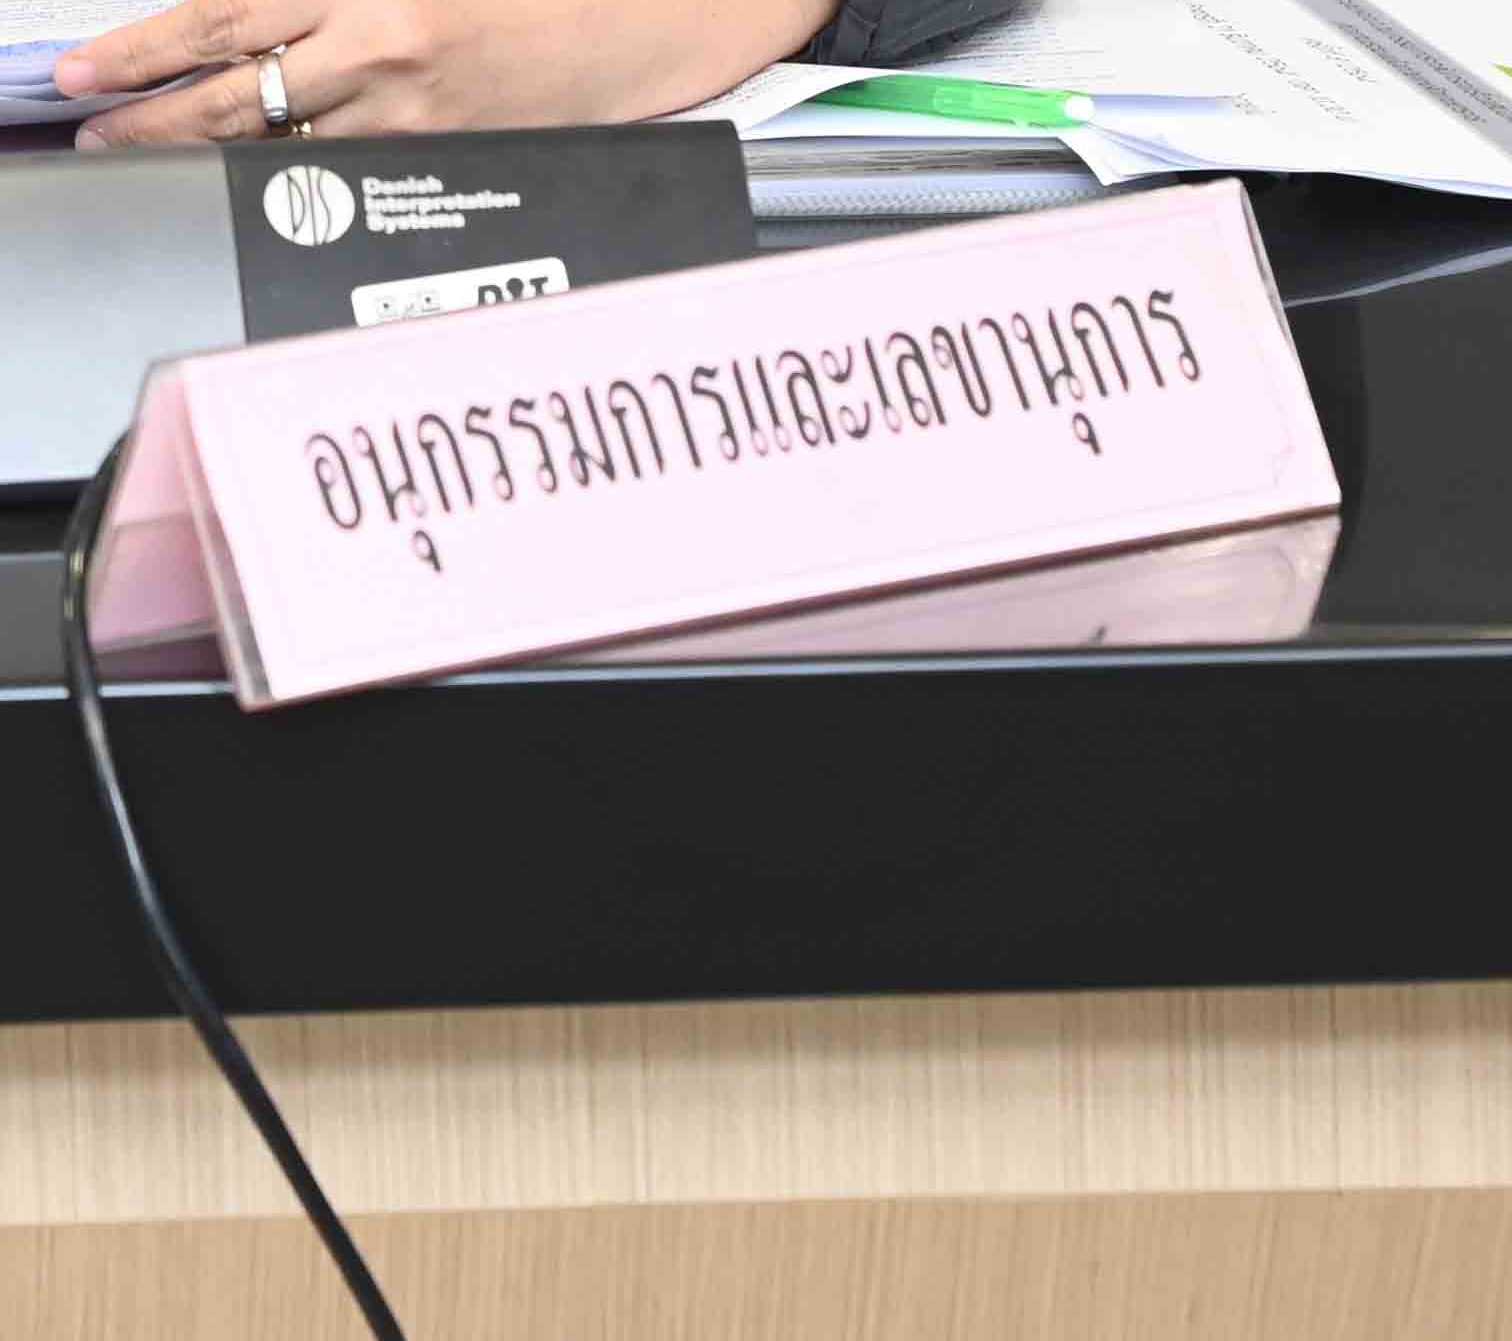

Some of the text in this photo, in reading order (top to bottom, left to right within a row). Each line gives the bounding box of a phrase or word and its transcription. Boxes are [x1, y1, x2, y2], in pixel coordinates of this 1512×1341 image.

[361, 175, 443, 197] Danish
[364, 189, 520, 214] Interpretation
[366, 212, 465, 234] Systems
[304, 288, 1205, 571] อนุกรรมการและเลขานุการ
